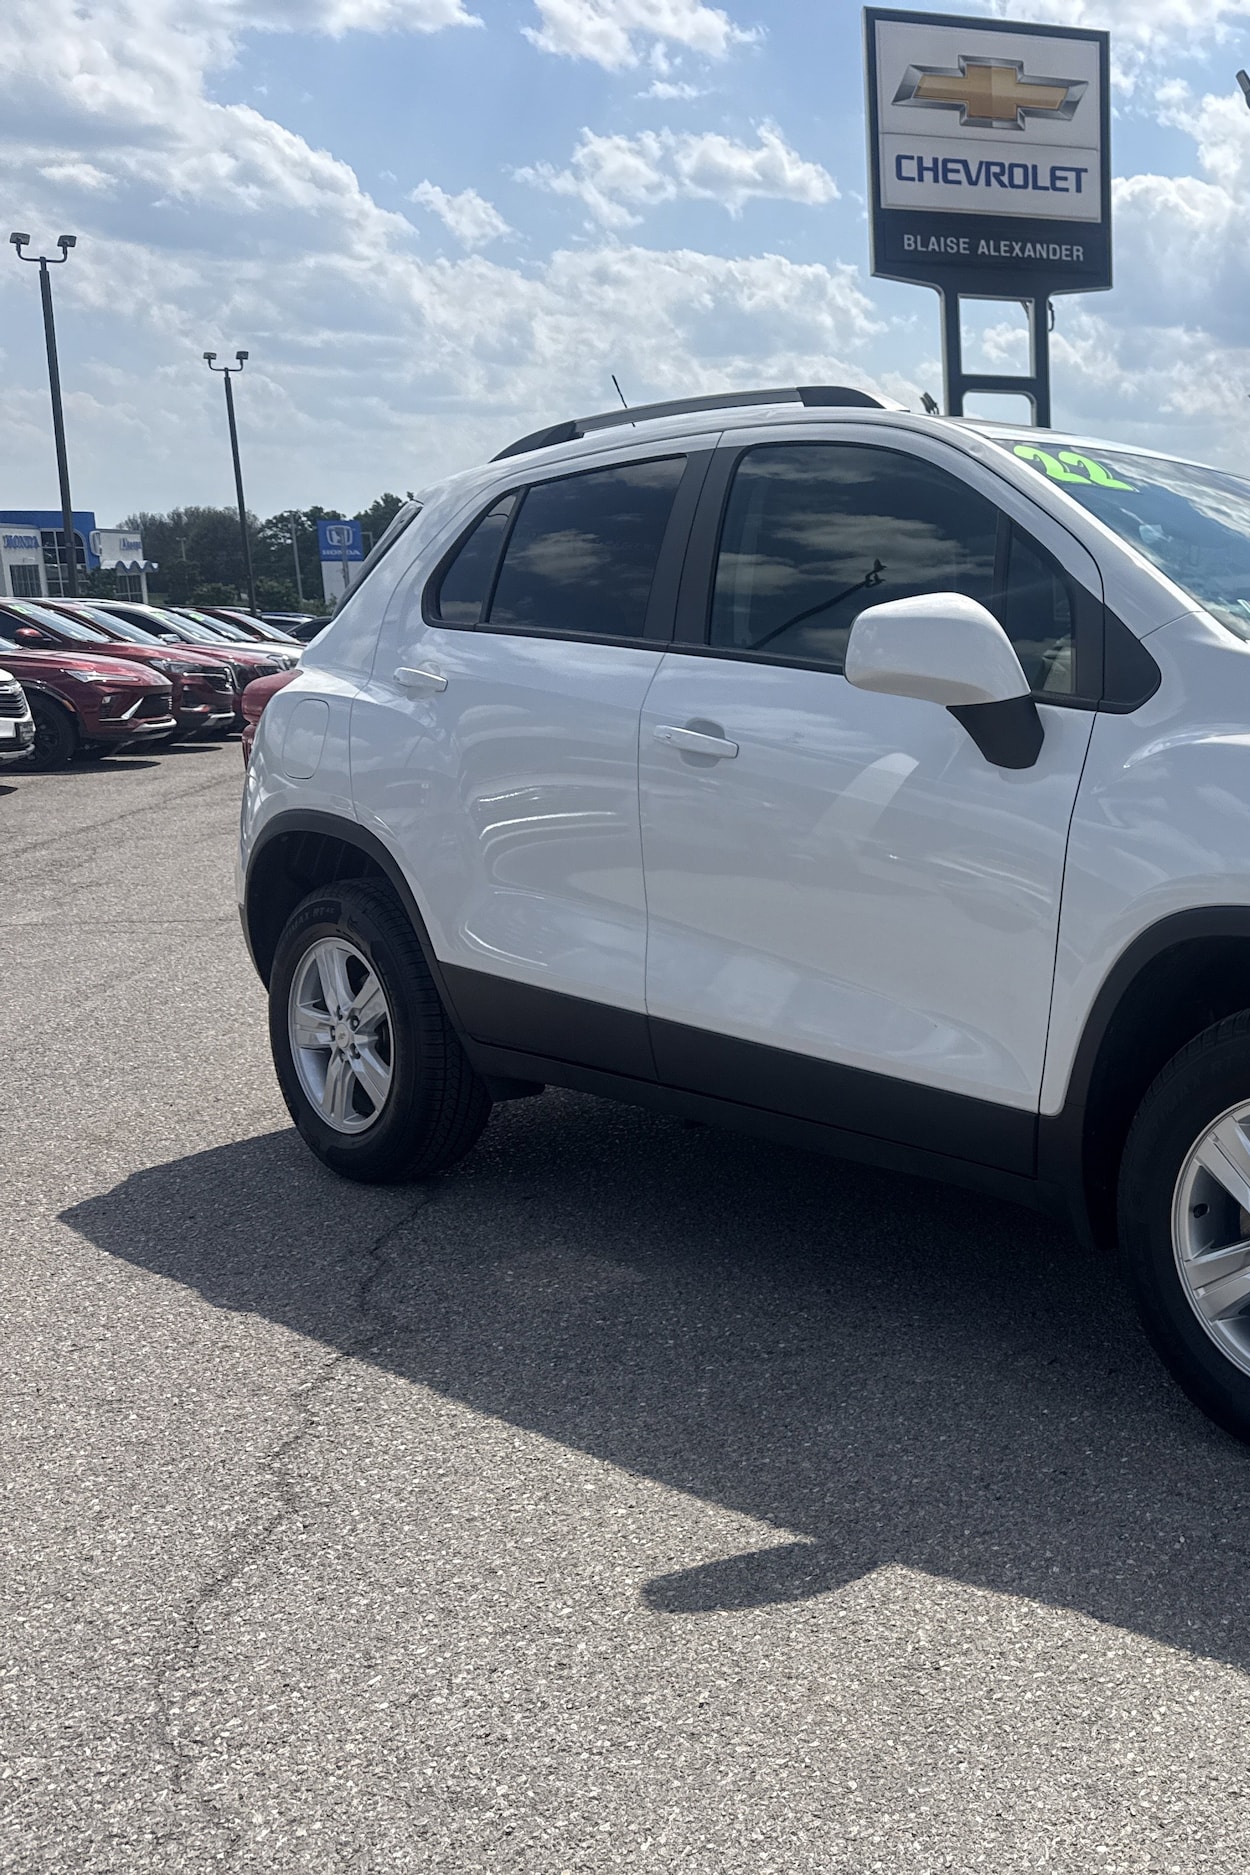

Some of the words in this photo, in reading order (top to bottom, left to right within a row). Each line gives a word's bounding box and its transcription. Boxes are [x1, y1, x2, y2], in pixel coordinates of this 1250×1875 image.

[895, 154, 1088, 194] CHEVROLET
[903, 234, 970, 254] BLAISE
[977, 239, 1084, 262] ALEXANDER
[1013, 445, 1140, 493] 22
